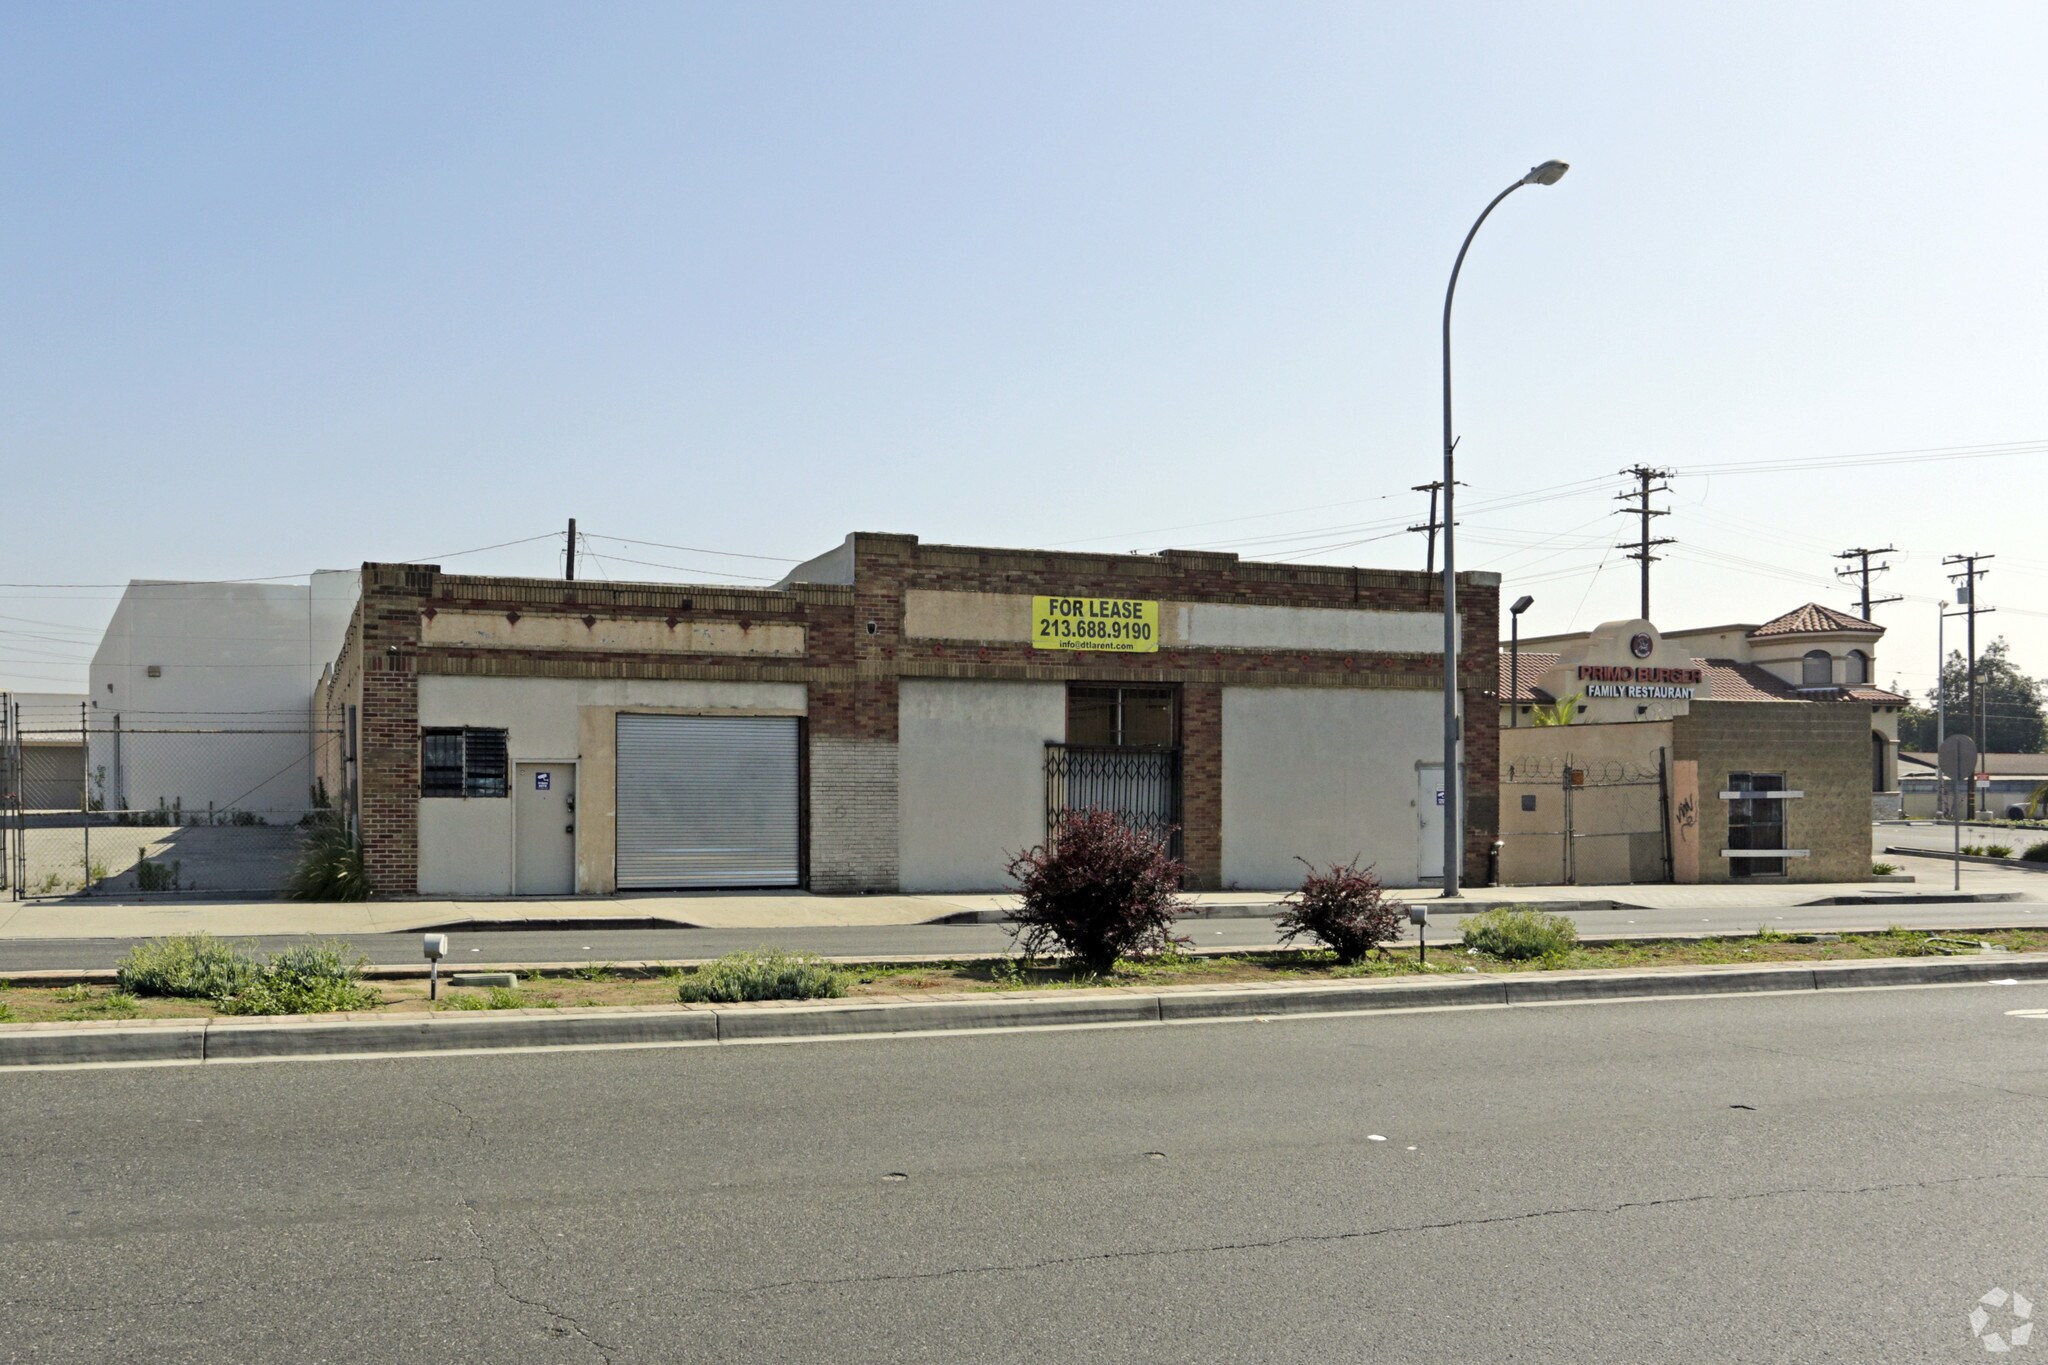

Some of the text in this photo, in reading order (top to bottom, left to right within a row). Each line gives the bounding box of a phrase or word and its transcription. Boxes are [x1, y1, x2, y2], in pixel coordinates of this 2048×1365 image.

[1049, 598, 1143, 619] FOR LEASE
[1040, 618, 1151, 640] 213.688.9190
[1059, 640, 1134, 650] info@dtlarent.com
[1579, 665, 1702, 683] PRIMO BURGER
[1587, 685, 1695, 699] FAMILY RESTAURANT
